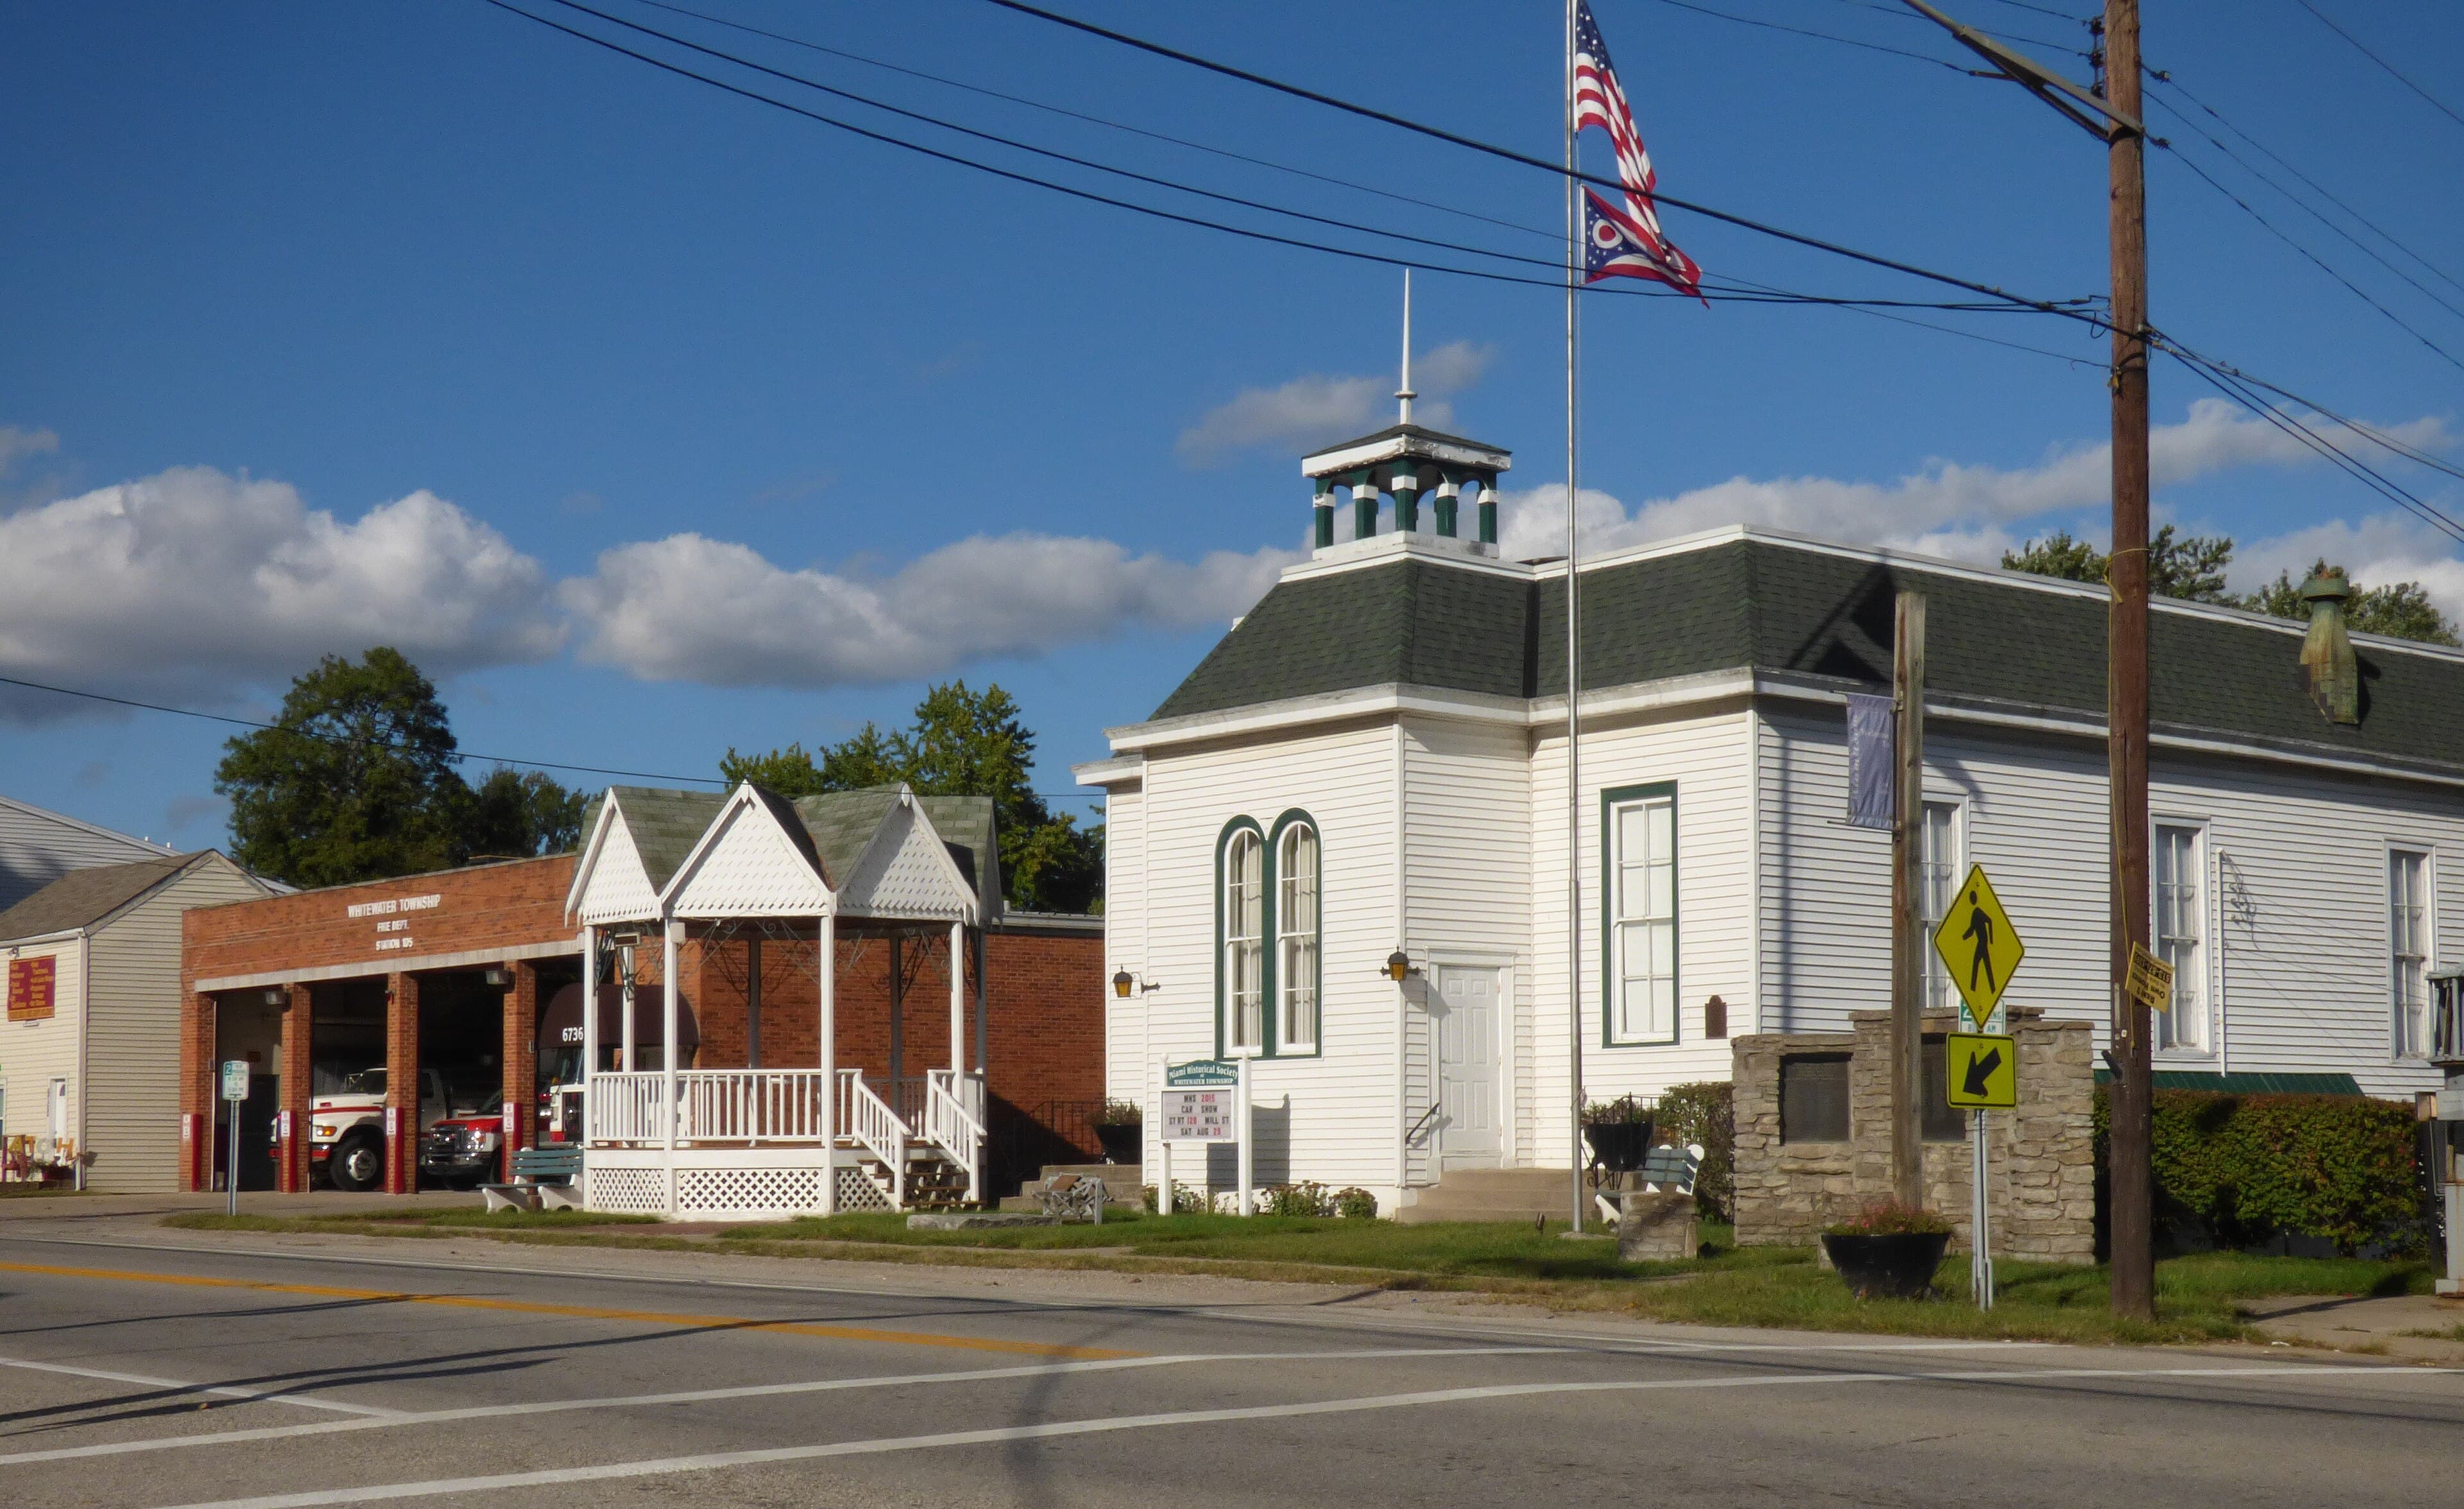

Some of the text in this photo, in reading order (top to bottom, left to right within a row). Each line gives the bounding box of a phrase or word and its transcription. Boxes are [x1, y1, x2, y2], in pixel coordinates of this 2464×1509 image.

[348, 894, 441, 918] WHITEWATER TOWNSHIP
[377, 921, 391, 932] FIRE
[376, 938, 400, 951] STATION
[562, 1027, 583, 1042] 6736
[225, 1064, 232, 1074] 2
[1168, 1065, 1237, 1079] Miami Historical Society
[1201, 1094, 1215, 1103] 2015
[1181, 1105, 1217, 1114] CAR SHOW
[1205, 1117, 1219, 1125] MILL
[1222, 1116, 1229, 1125] ST
[1181, 1127, 1192, 1135] SAT
[1197, 1127, 1209, 1135] AUG
